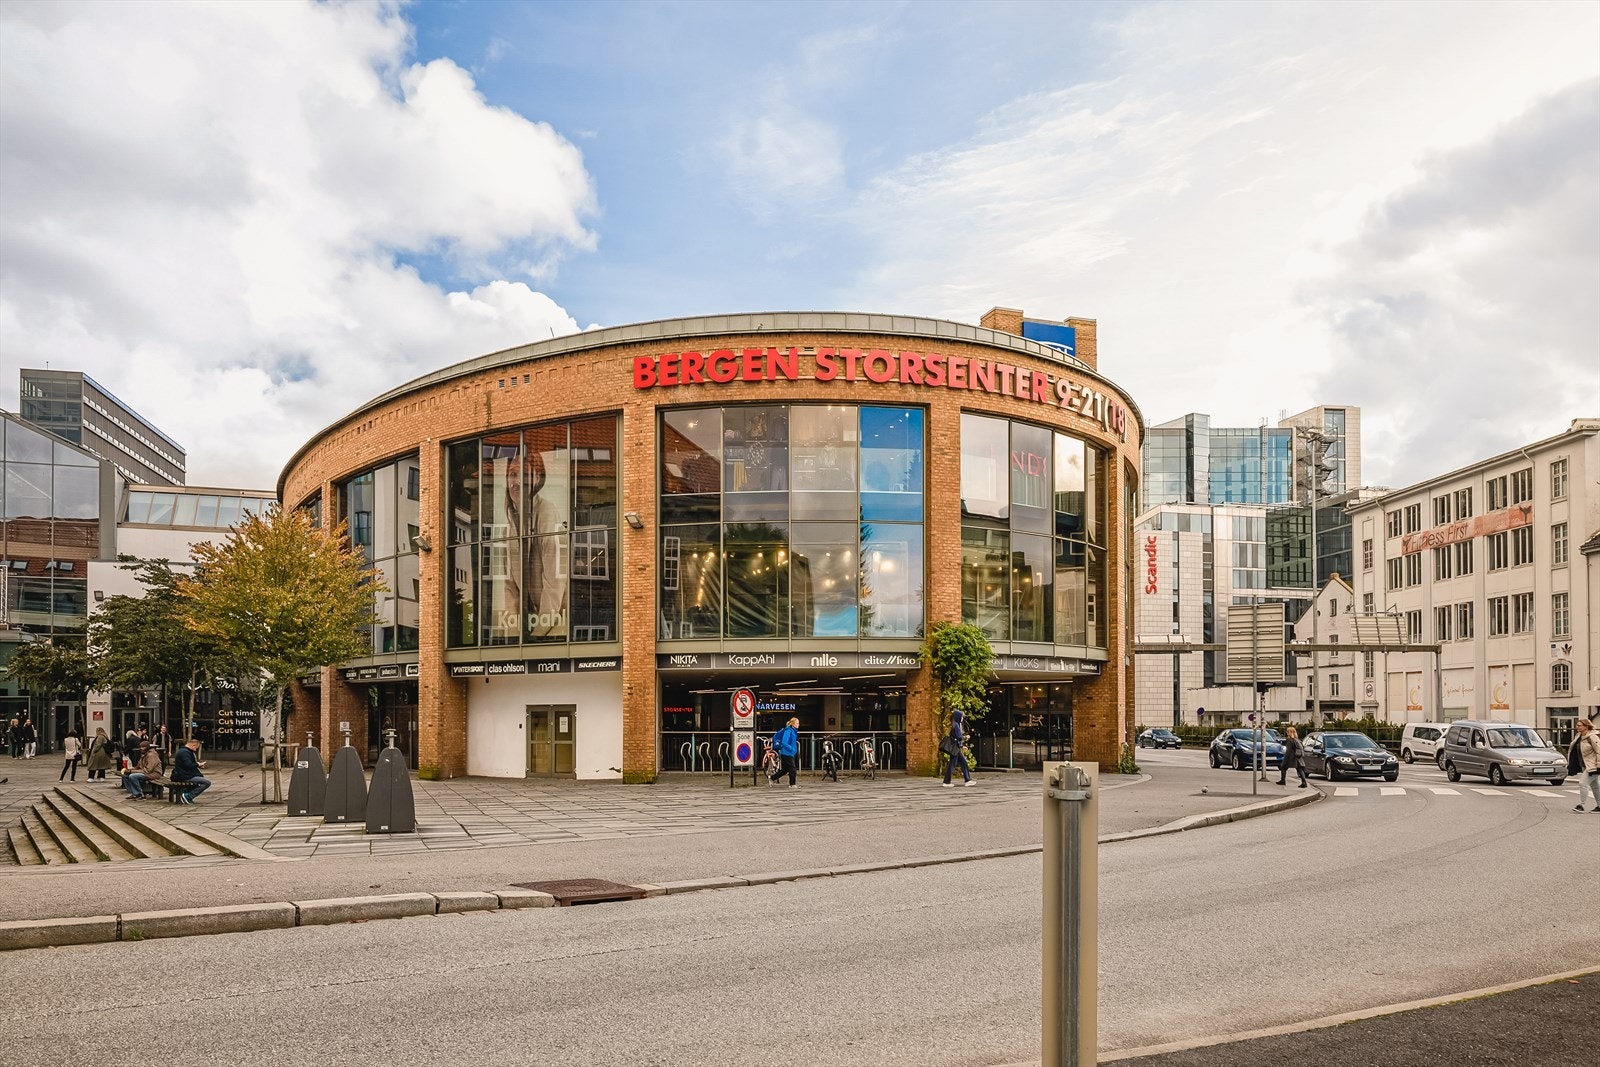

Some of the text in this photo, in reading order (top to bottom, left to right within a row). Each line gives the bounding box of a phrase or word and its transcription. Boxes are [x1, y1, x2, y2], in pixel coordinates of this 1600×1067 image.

[633, 347, 799, 390] BERGEN
[813, 346, 1049, 404] STORSENTER
[1447, 522, 1469, 542] First
[1145, 535, 1158, 595] Scandic
[578, 660, 617, 669] SKECHERS
[670, 655, 698, 665] NIKITA
[728, 654, 775, 667] KappAhl
[810, 653, 838, 667] nille
[1013, 657, 1040, 669] KICKS
[488, 663, 525, 673] clas ohlson
[218, 709, 257, 717] Cut time.
[235, 718, 254, 726] hair.
